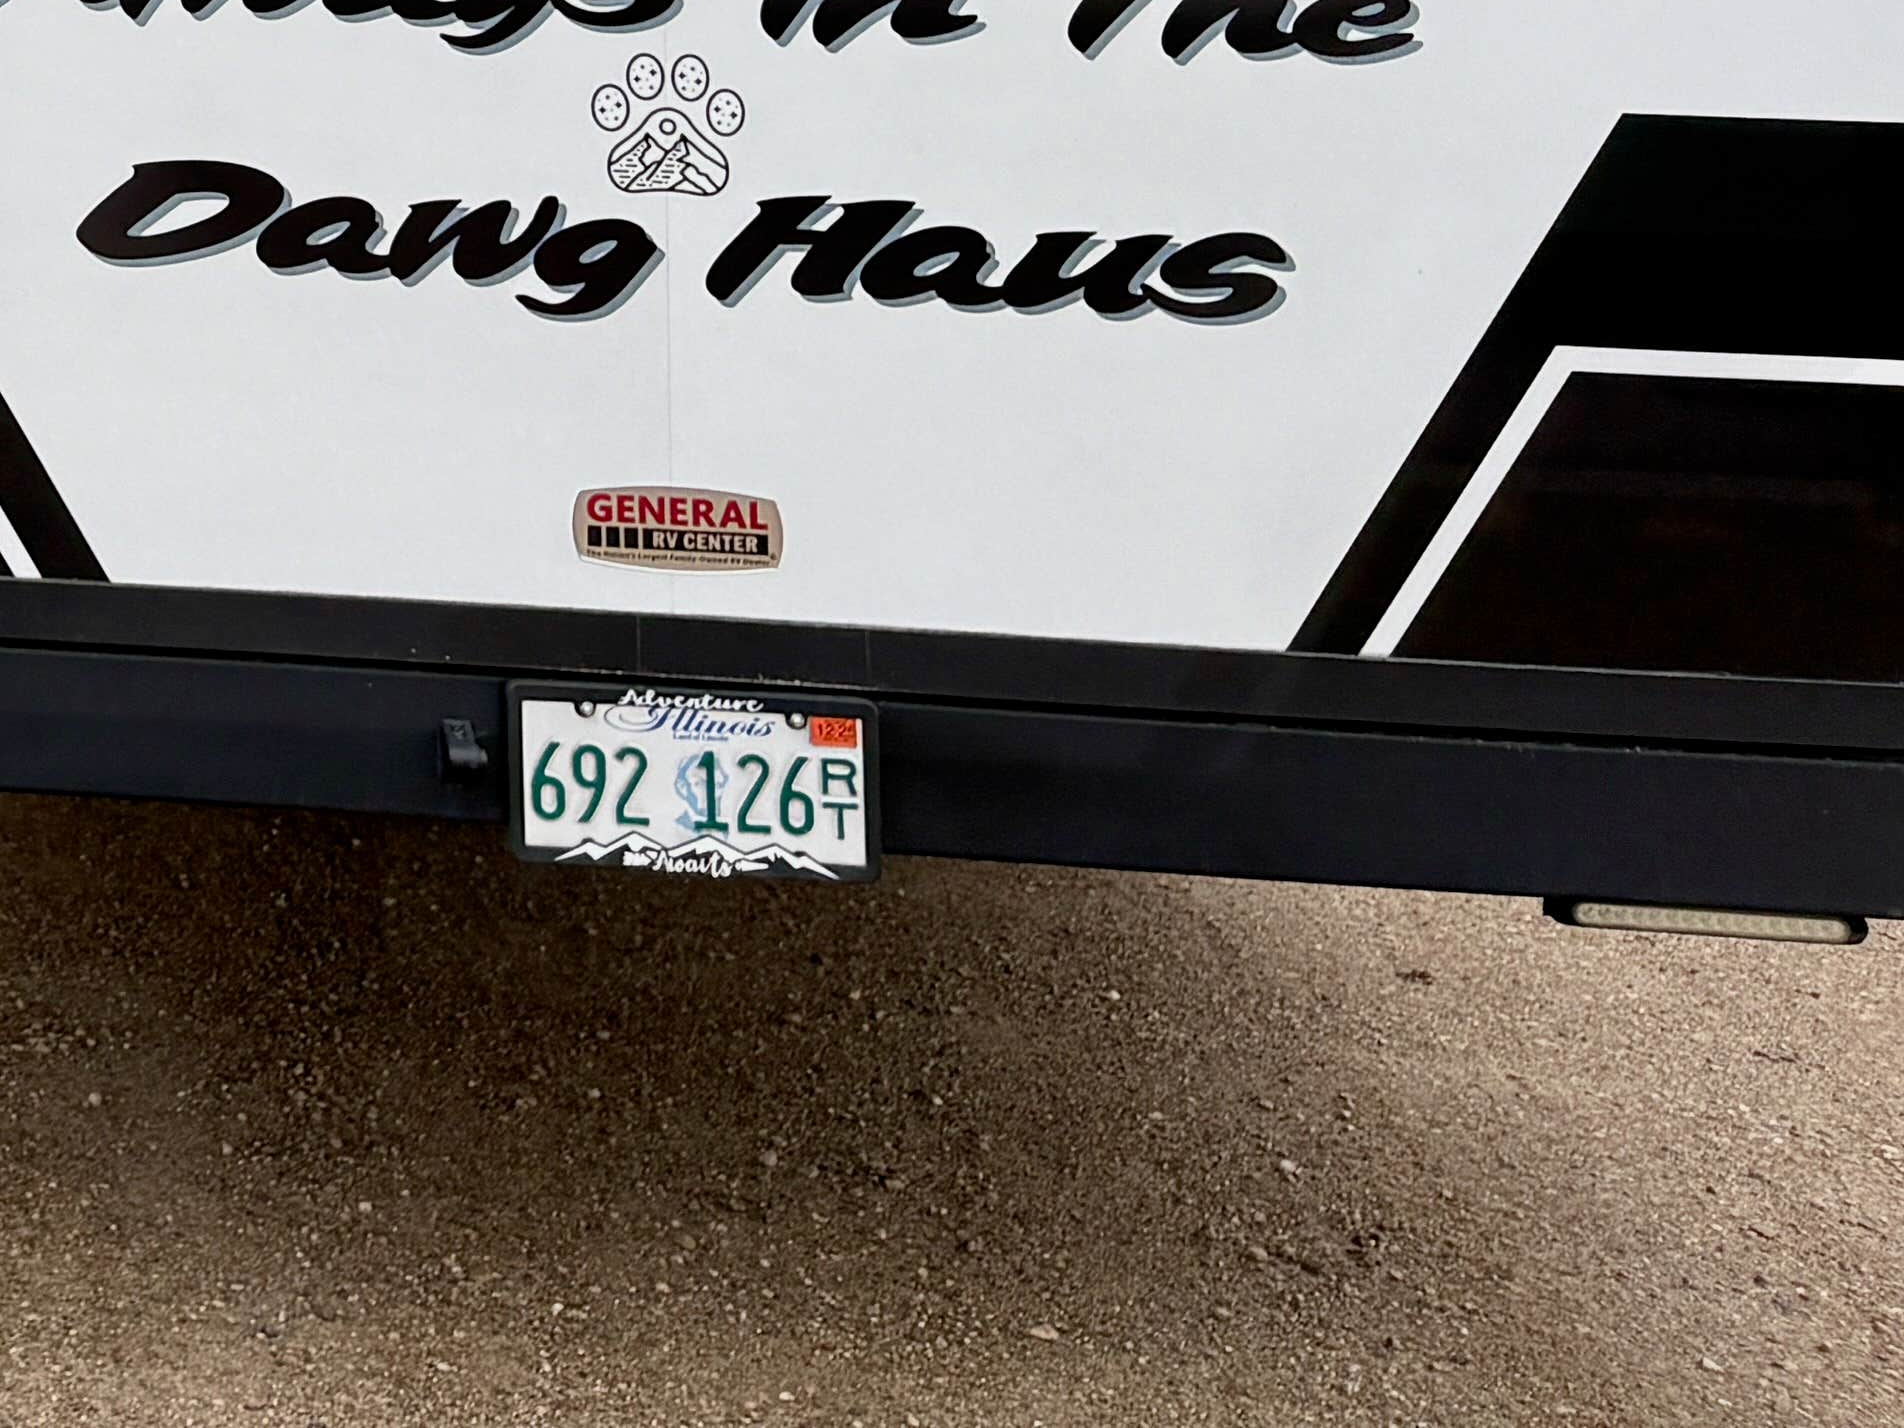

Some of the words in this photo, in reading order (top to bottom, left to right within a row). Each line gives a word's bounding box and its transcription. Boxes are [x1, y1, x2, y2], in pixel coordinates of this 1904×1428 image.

[75, 159, 666, 323] Dawg
[705, 194, 1297, 326] Haus
[586, 493, 769, 531] GENERAL
[652, 531, 678, 549] RV
[683, 532, 759, 553] CENTER
[618, 689, 765, 713] Adventure
[604, 705, 775, 737] Illinois
[531, 742, 650, 828] 692
[692, 750, 816, 836] 126
